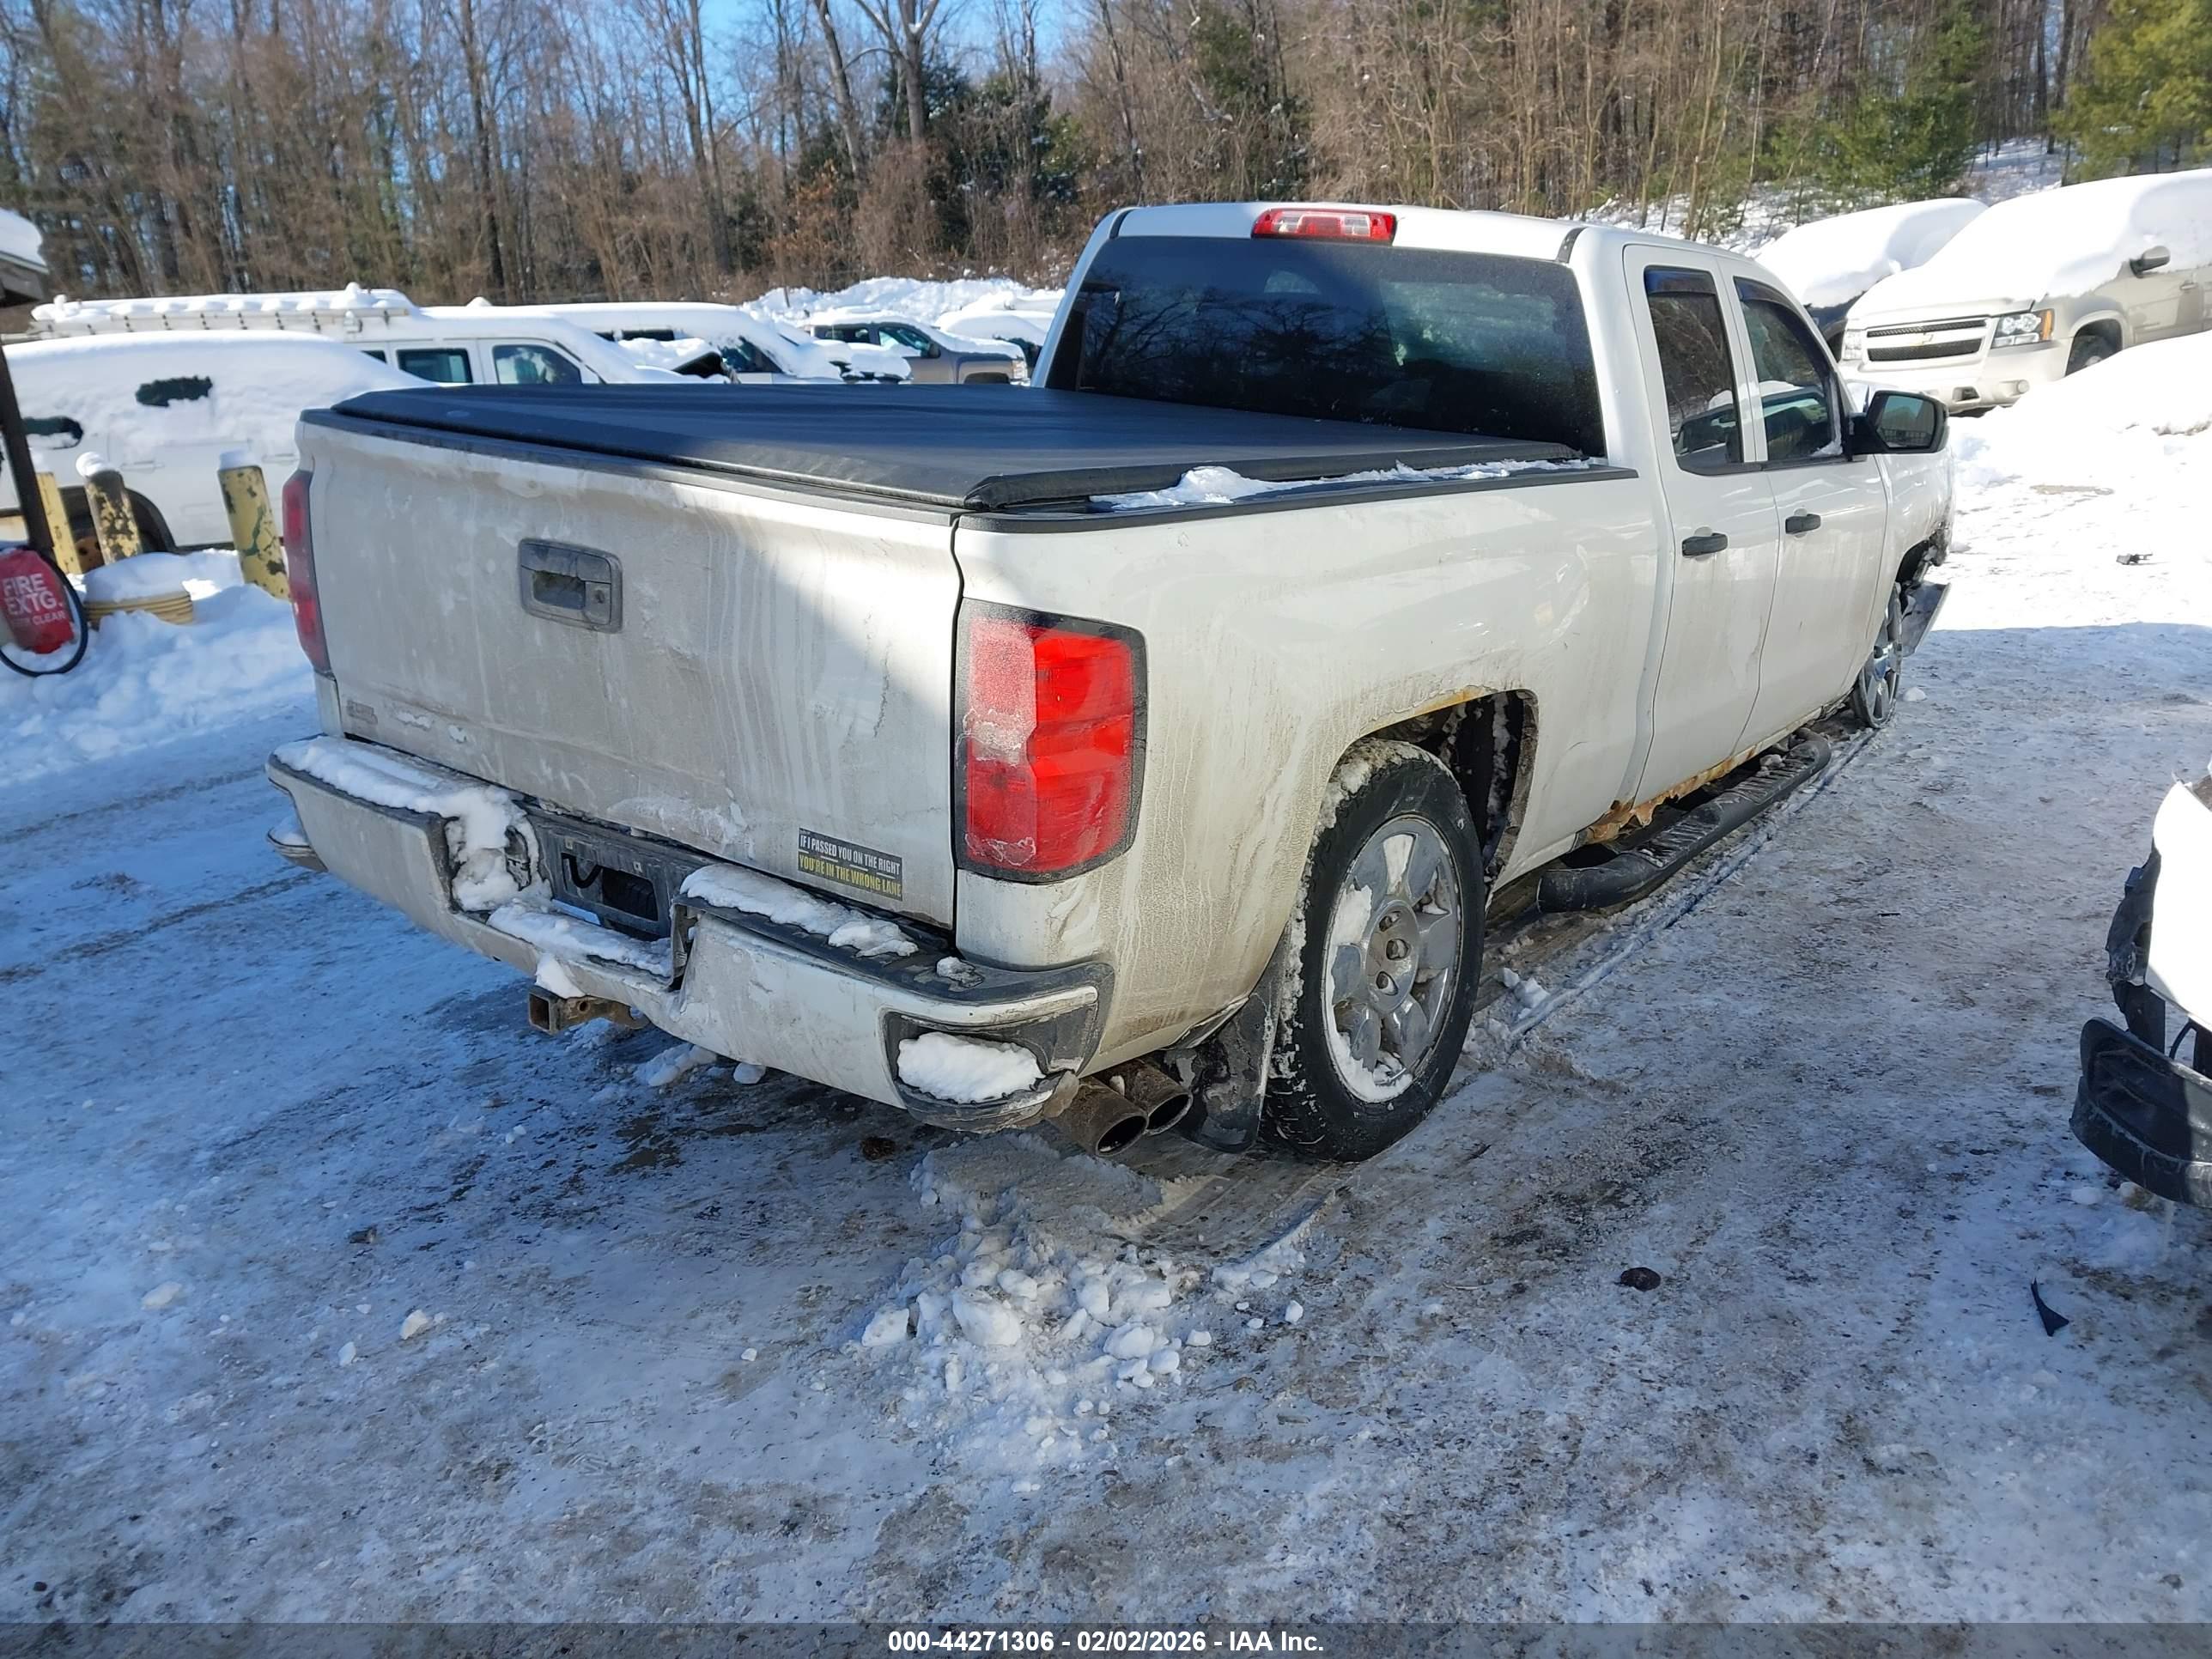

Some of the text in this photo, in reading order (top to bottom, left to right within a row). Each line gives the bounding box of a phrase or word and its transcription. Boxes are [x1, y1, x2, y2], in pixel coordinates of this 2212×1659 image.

[3, 573, 47, 597] FIRE
[3, 591, 63, 615] EXTG.
[800, 835, 807, 848] IF
[811, 838, 837, 857] PASSED
[837, 845, 853, 861] YOU
[853, 850, 863, 865] ON
[864, 854, 878, 869] THE
[878, 858, 901, 875] RIGHT
[799, 854, 902, 897] YOU'RE IN THE WRONG LANE
